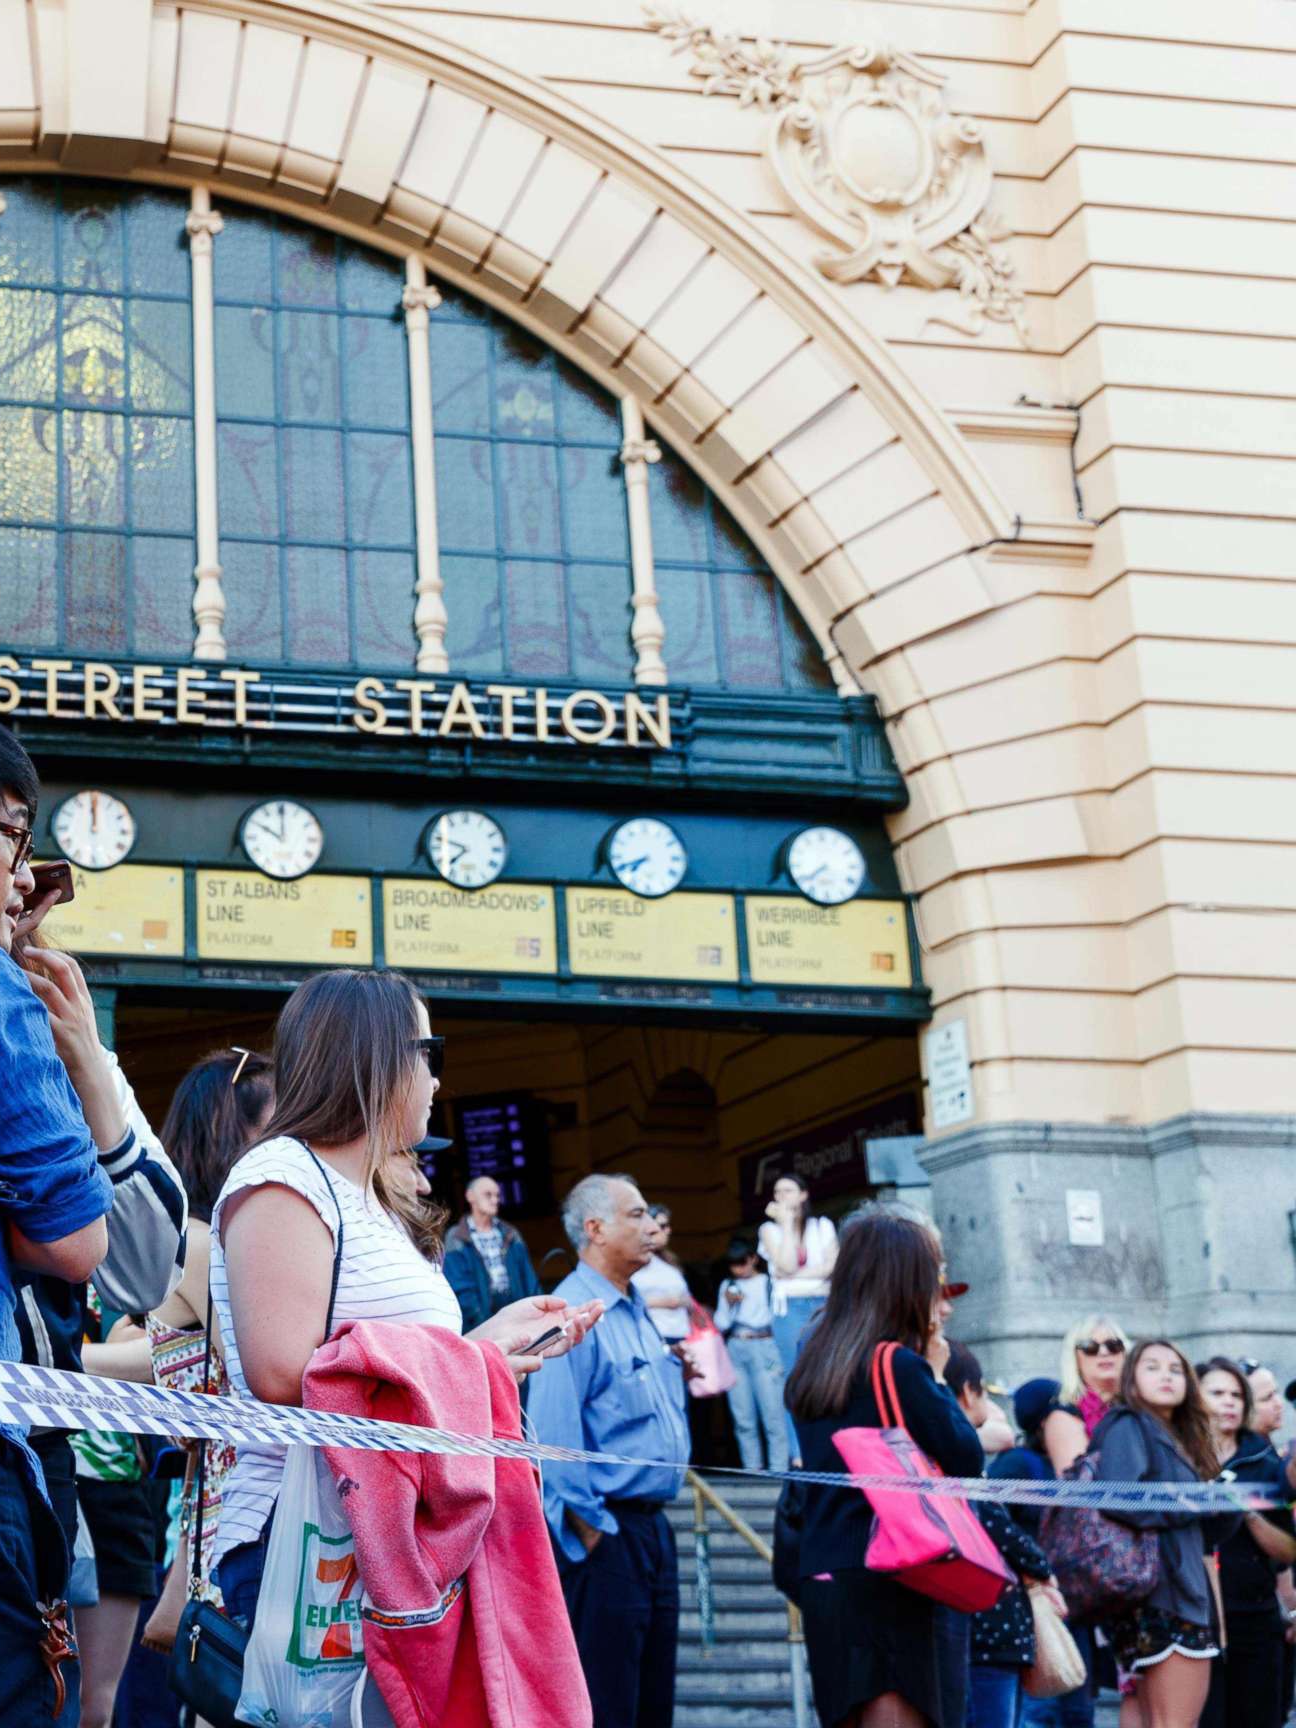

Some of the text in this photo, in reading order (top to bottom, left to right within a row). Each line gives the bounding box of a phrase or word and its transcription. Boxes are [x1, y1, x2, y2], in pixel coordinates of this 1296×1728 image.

[353, 676, 672, 749] STATION
[206, 880, 301, 901] ST ALBANS
[392, 889, 541, 912] BROADMEADOWS
[576, 897, 646, 917] UPFIELD
[206, 904, 245, 923] LINE
[394, 913, 431, 932] LINE
[755, 906, 841, 926] WERRIBEE
[206, 930, 274, 947] PLATFORM
[577, 921, 614, 939] LINE
[757, 930, 793, 948] LINE
